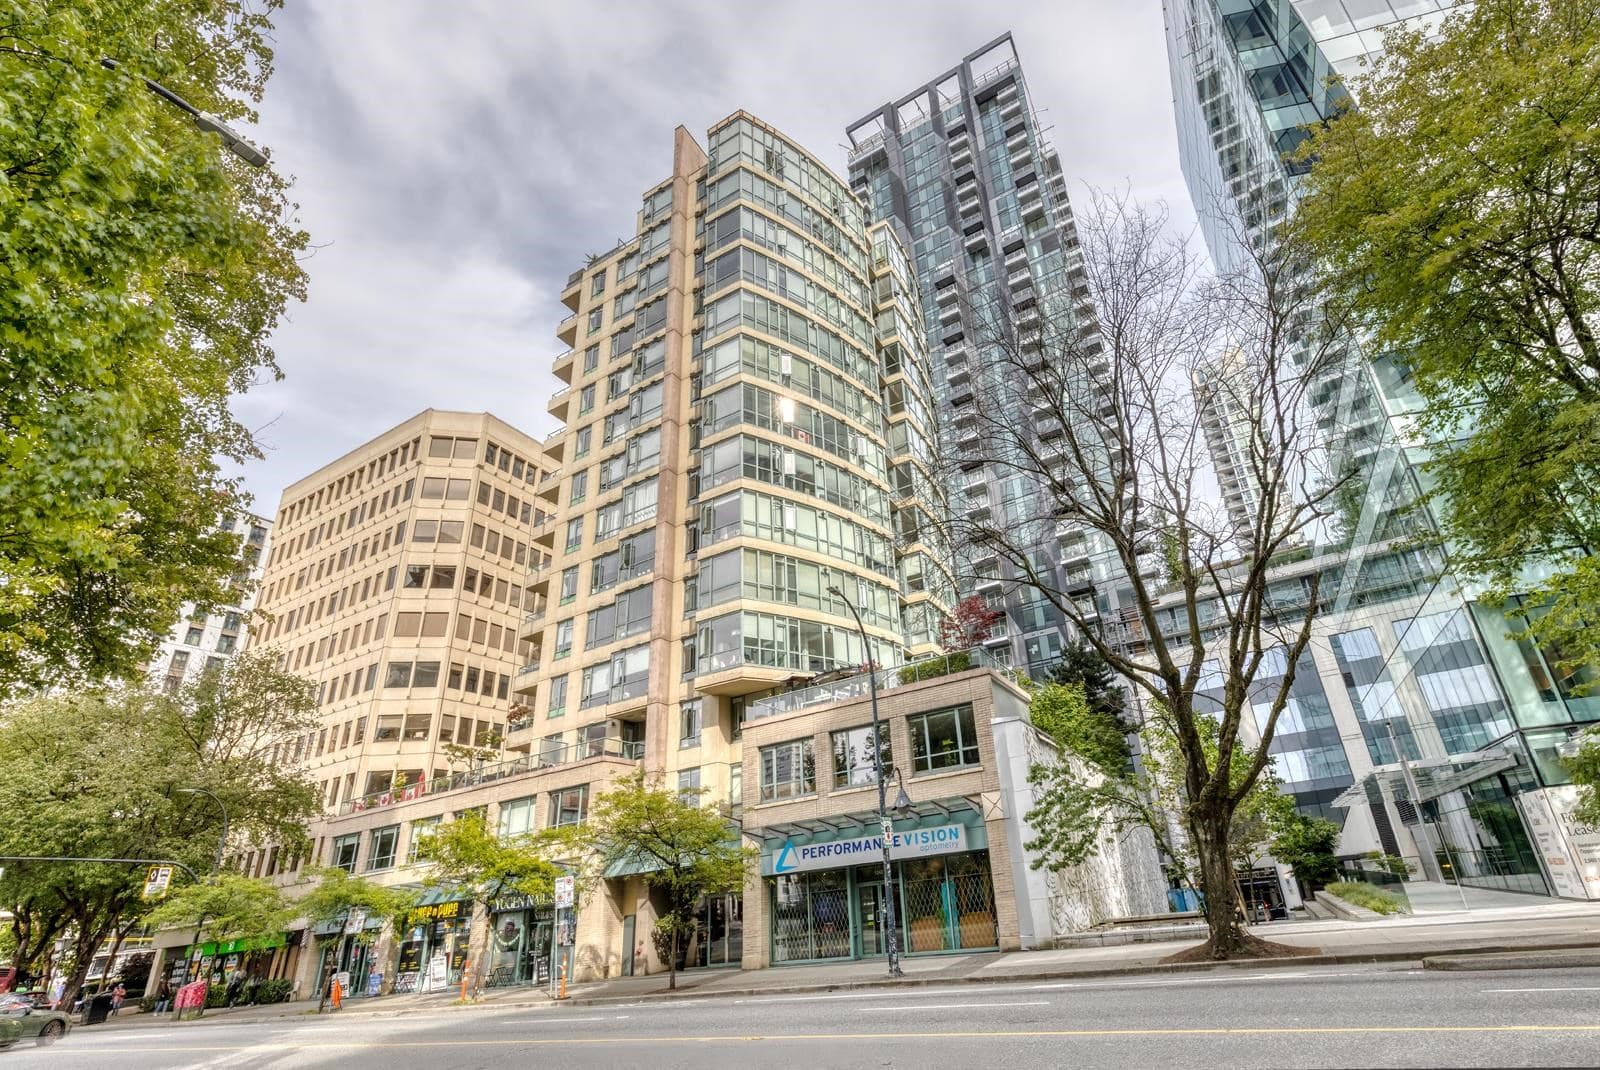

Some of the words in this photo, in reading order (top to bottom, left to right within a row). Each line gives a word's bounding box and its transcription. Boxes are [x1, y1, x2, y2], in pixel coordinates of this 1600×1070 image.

[1566, 824, 1600, 836] Lease
[802, 835, 901, 859] PERFORMANE
[904, 827, 960, 847] VISION
[920, 841, 959, 852] optometry
